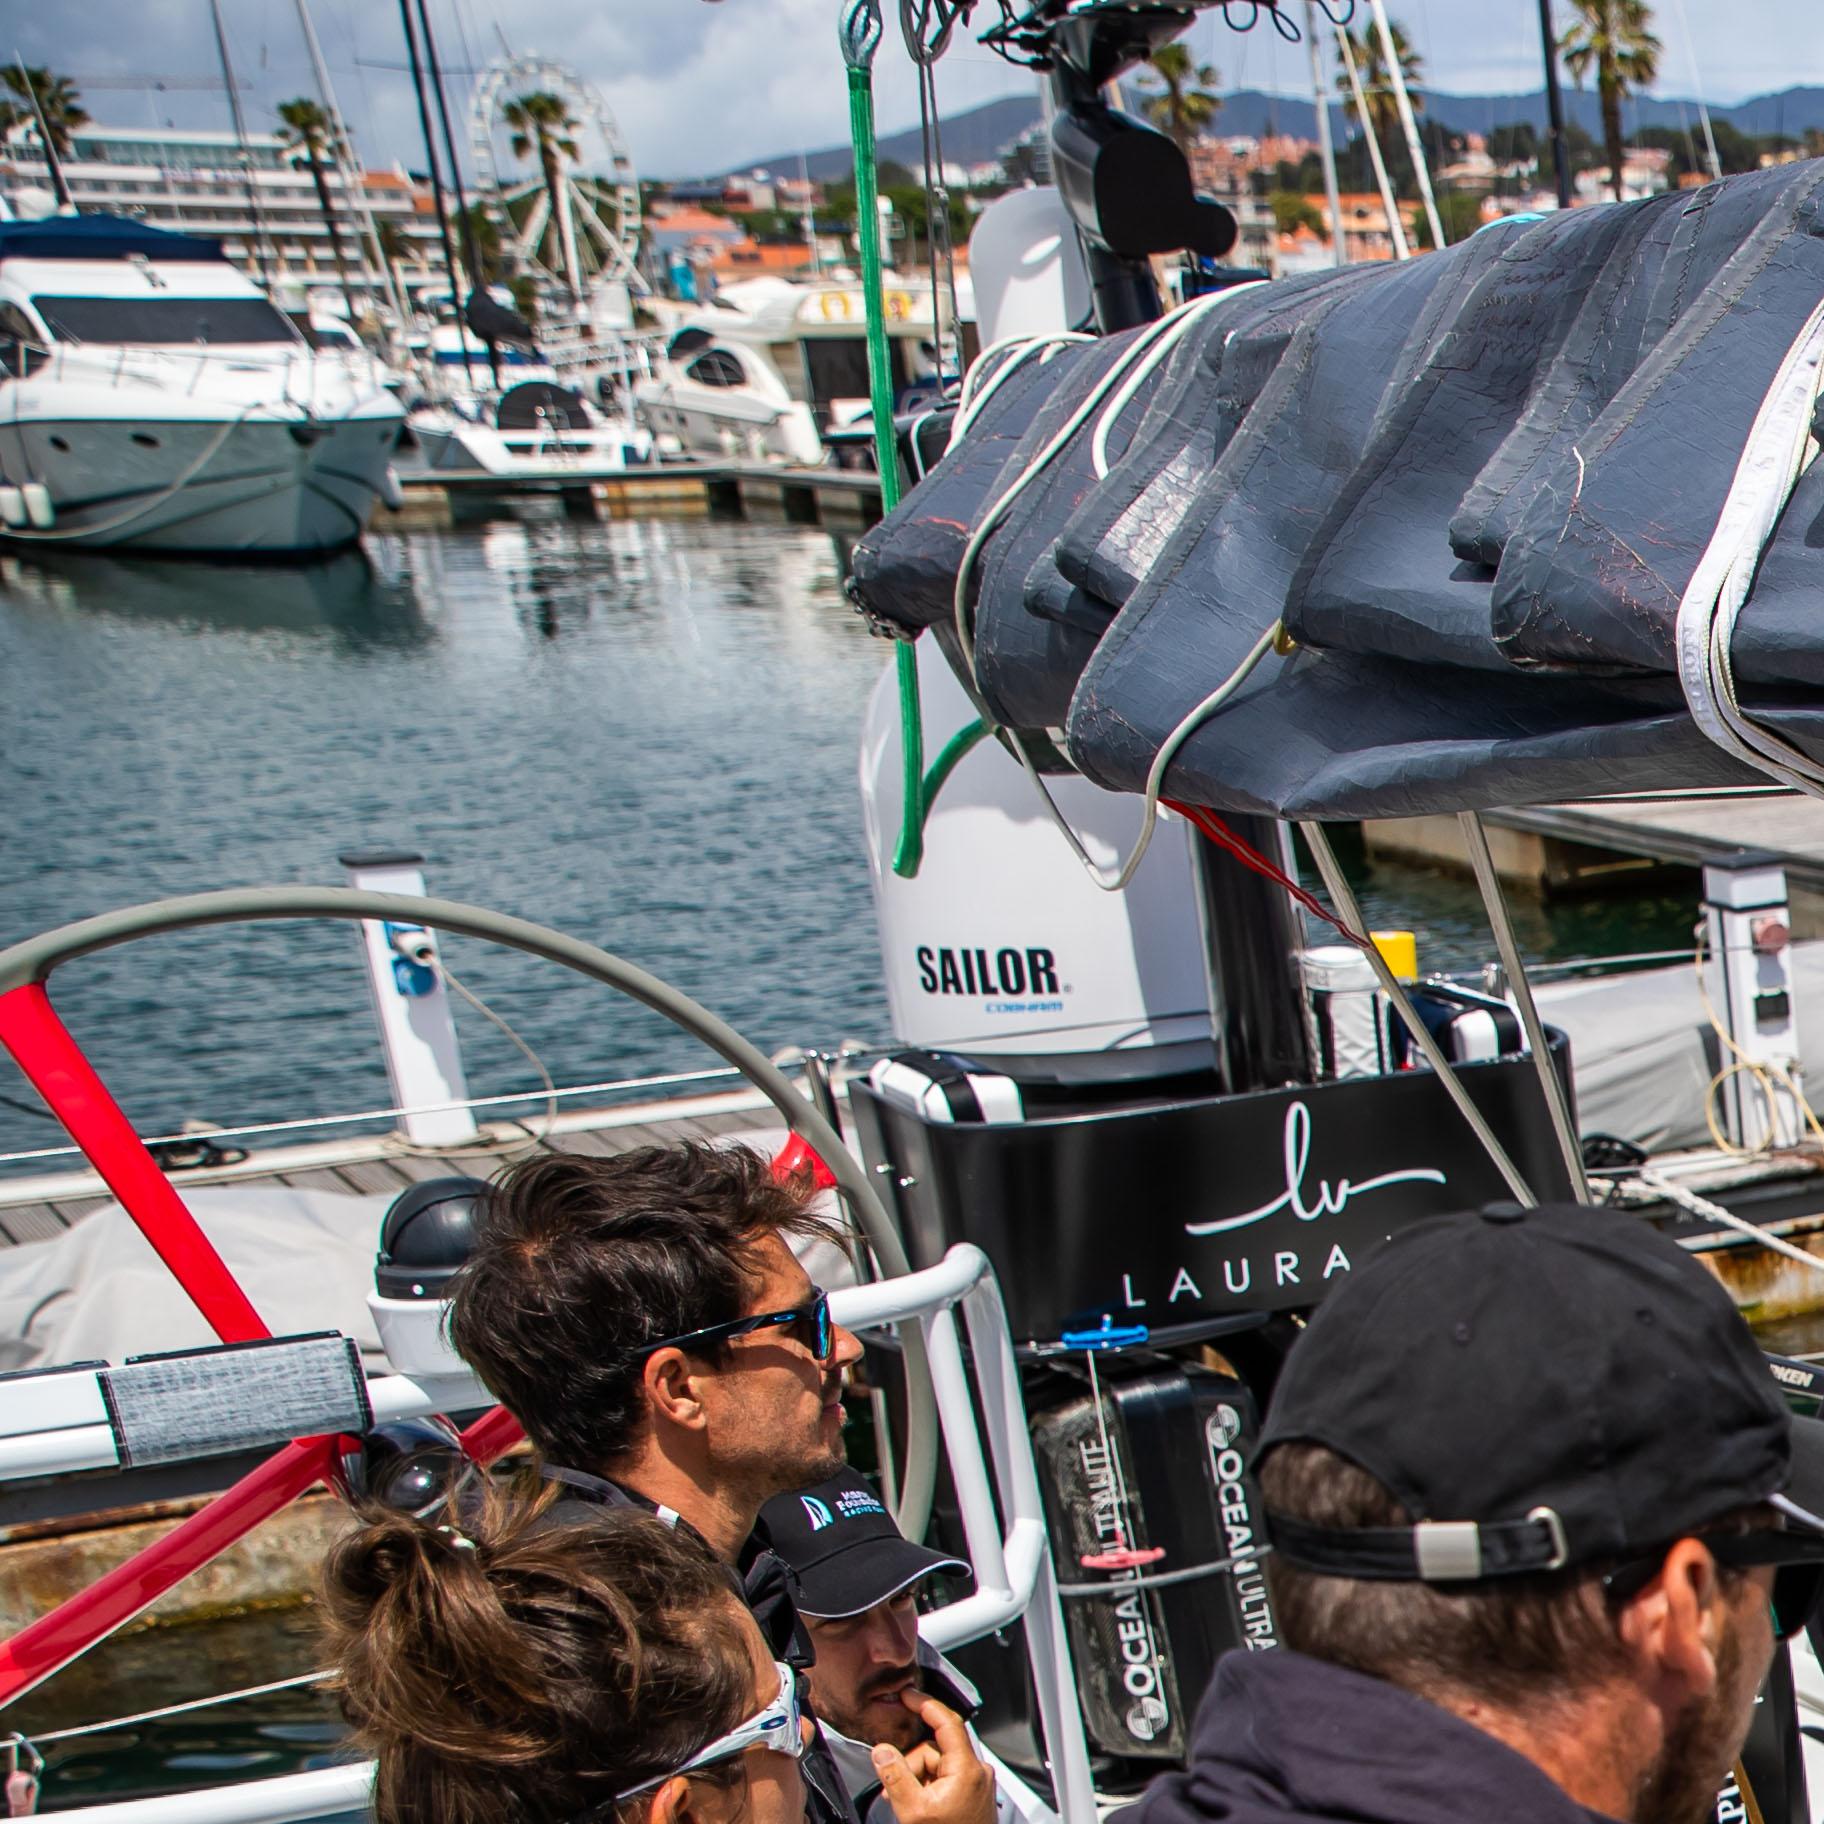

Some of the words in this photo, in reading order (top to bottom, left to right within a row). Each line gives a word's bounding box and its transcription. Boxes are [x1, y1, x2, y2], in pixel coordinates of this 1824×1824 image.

[916, 945, 1060, 996] SAILOR
[1123, 1244, 1351, 1308] LAURA
[1217, 1449, 1260, 1576] OCEAN
[1110, 1566, 1157, 1698] OCEAN
